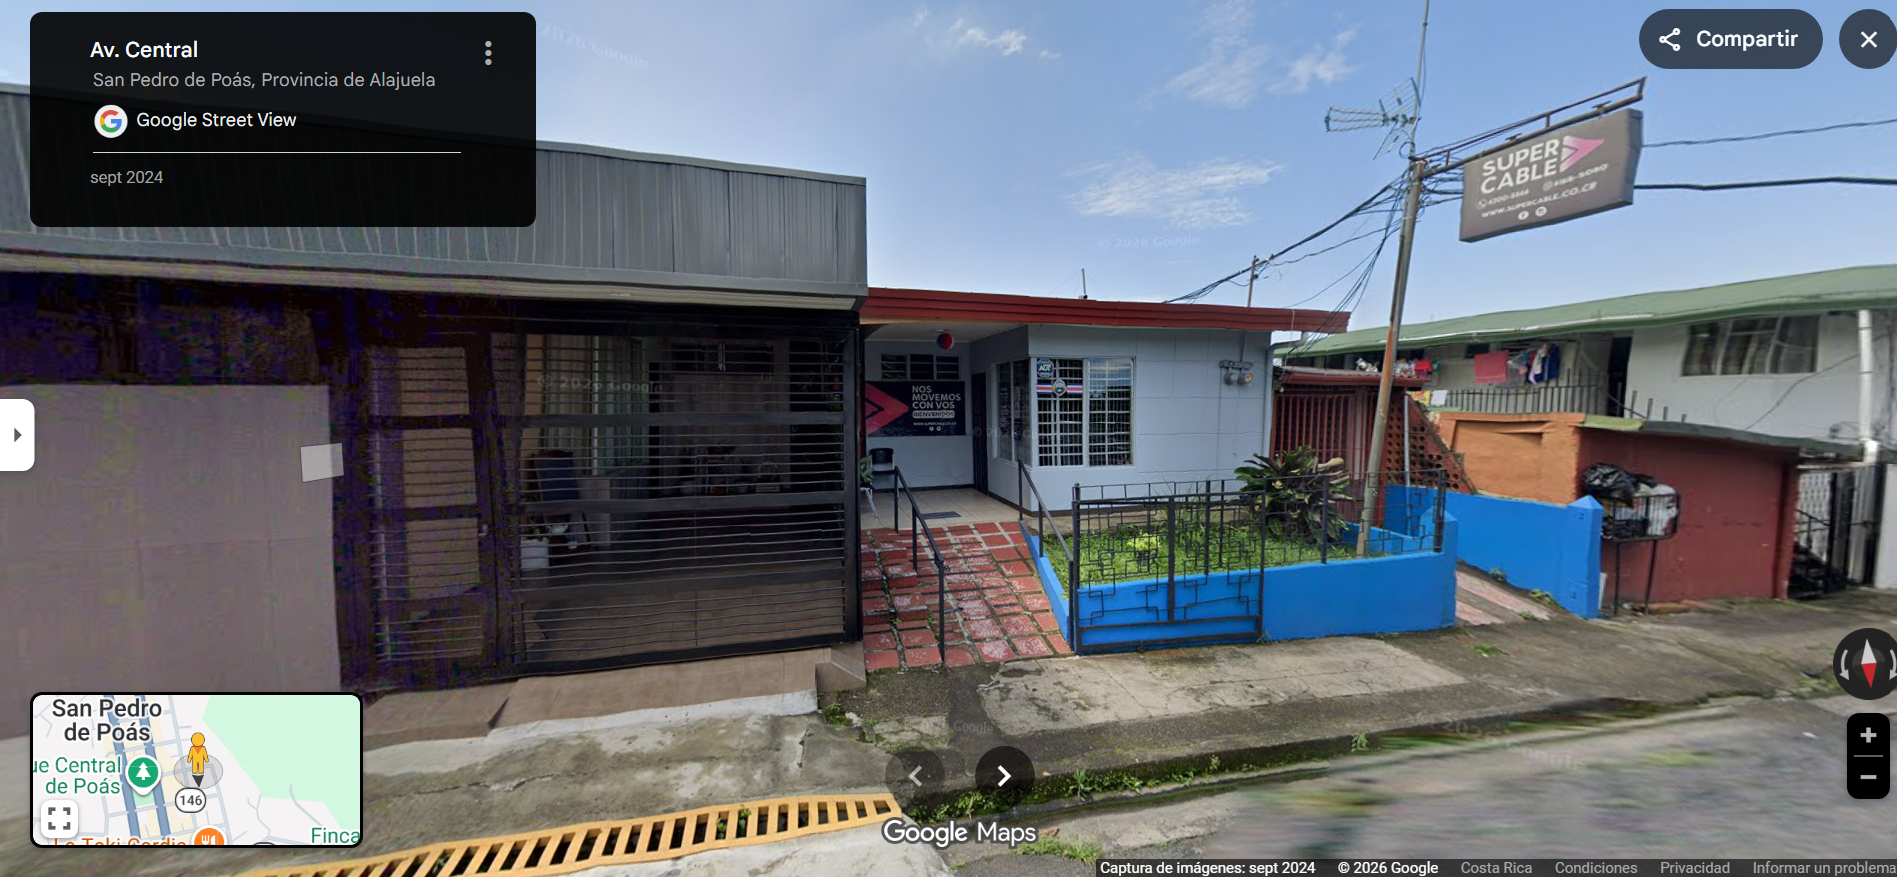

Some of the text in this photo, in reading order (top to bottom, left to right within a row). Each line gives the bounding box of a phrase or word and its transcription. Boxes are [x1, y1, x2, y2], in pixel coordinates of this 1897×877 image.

[1482, 139, 1560, 176] SUPER
[1480, 158, 1558, 194] CABLE
[911, 385, 932, 394] NOS
[912, 393, 962, 402] MOVEMOS
[912, 401, 955, 409] CON VOS
